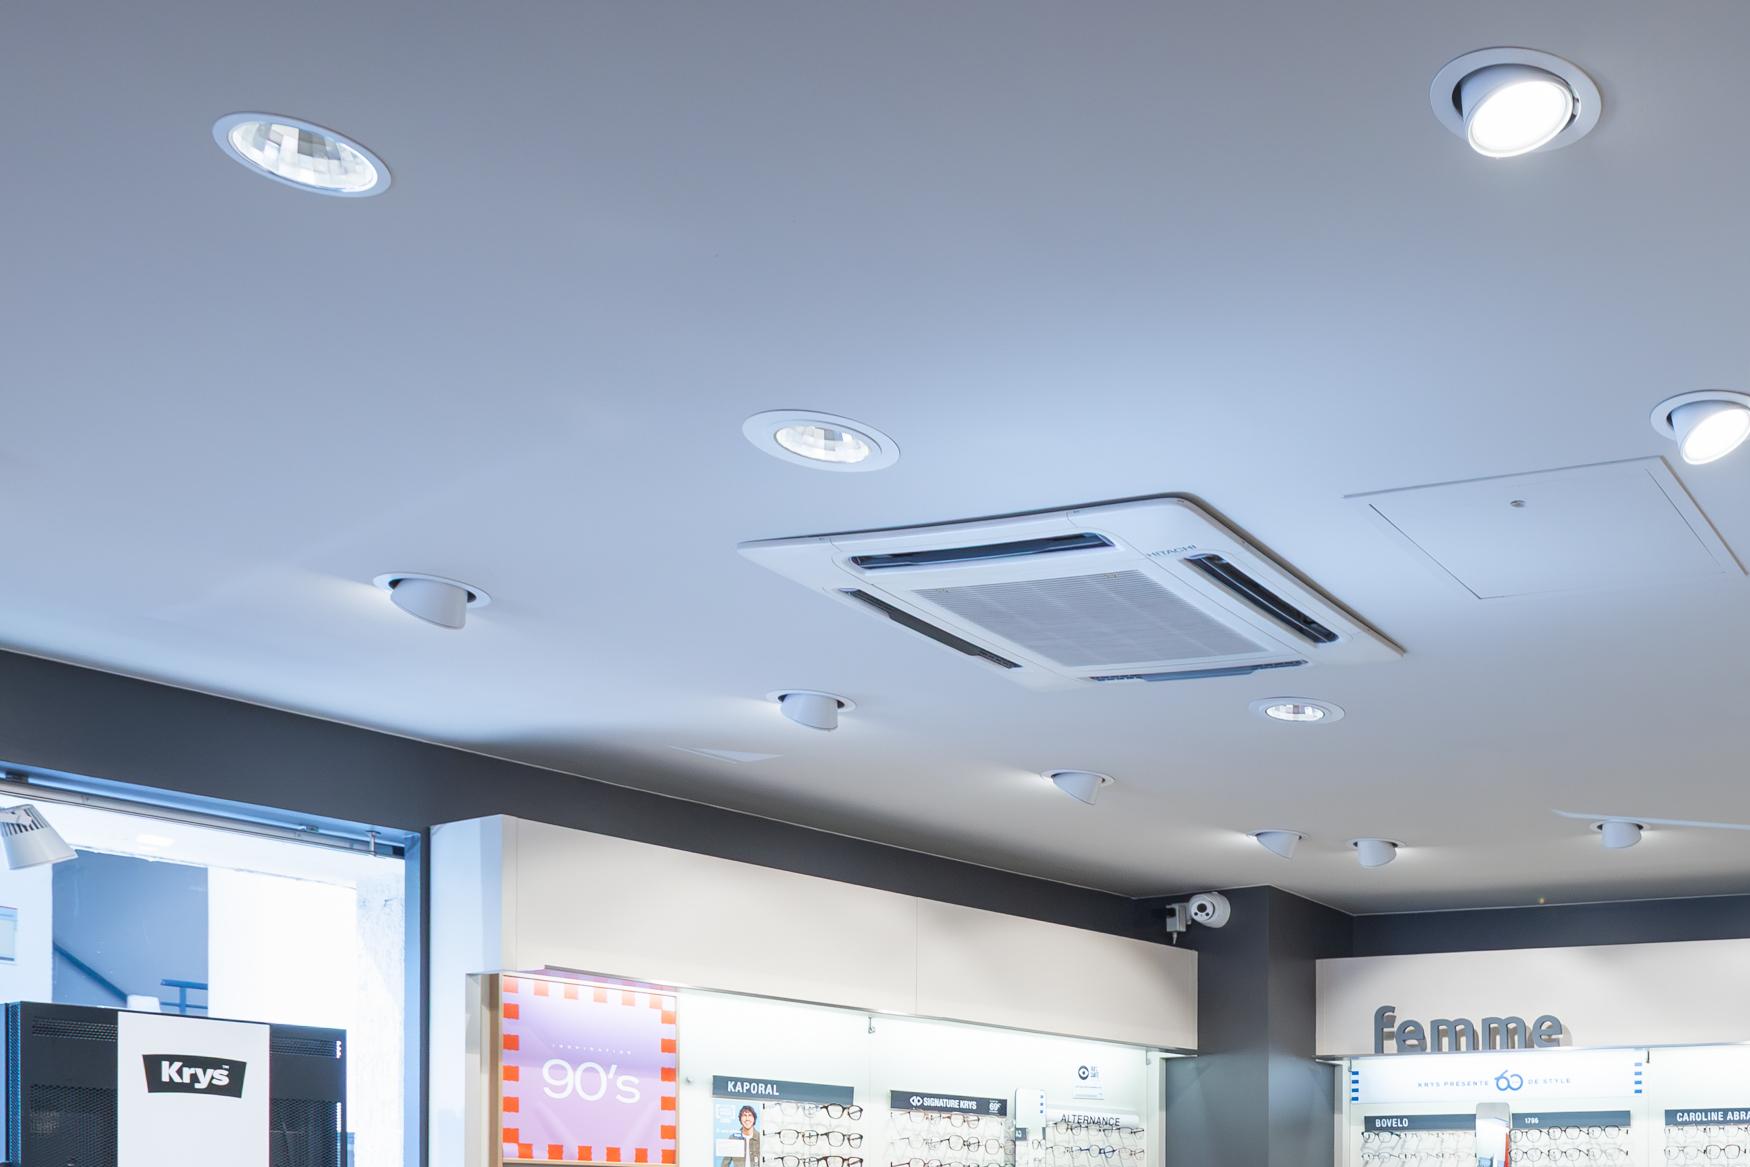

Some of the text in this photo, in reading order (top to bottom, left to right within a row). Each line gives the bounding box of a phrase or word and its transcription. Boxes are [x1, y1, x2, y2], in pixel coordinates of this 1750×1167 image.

[1374, 1004, 1563, 1055] femme
[160, 1060, 230, 1090] Krys
[542, 1058, 641, 1105] 90's
[1542, 1077, 1571, 1085] STYLE
[727, 1080, 780, 1096] KAPORAL
[922, 1096, 960, 1109] SIGNATURE
[959, 1099, 977, 1110] KRYS
[1060, 1113, 1121, 1127] ALTERNANCE
[1375, 1118, 1409, 1128] BOVELO
[1676, 1111, 1724, 1121] CAROLINE
